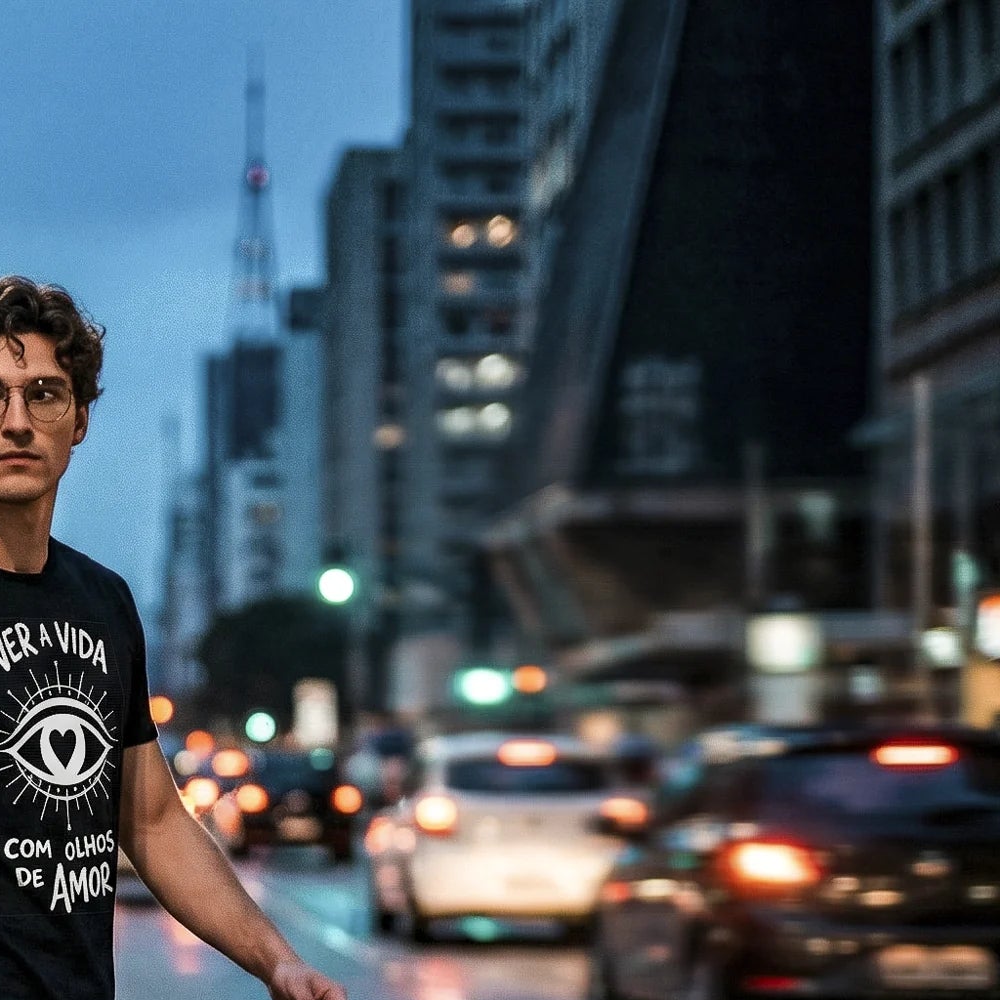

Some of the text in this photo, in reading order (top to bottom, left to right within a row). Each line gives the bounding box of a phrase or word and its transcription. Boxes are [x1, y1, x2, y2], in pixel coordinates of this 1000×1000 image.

[40, 623, 53, 648] A
[53, 621, 108, 674] VIDA
[4, 830, 115, 861] COM OLHOS
[15, 862, 113, 913] DE AMOR
